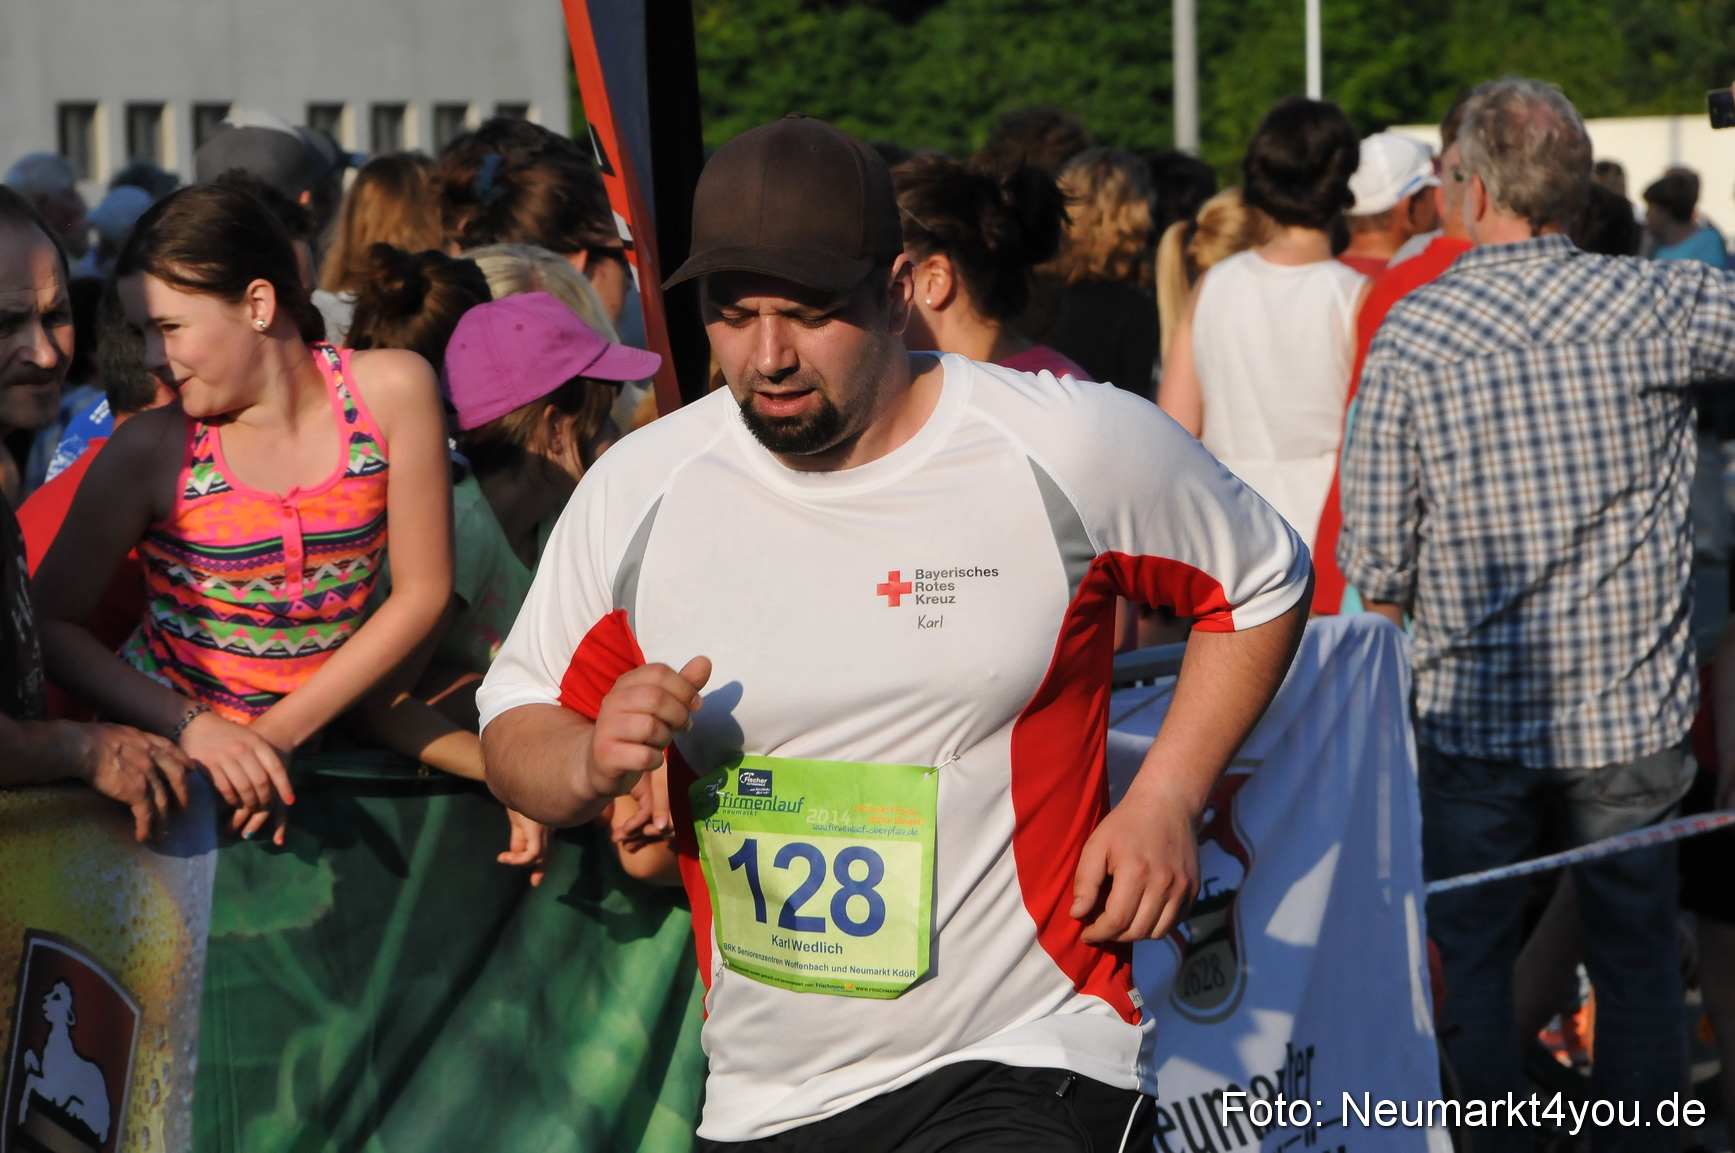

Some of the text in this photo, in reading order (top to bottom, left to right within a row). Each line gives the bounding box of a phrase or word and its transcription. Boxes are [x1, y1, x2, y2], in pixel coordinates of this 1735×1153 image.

[915, 566, 999, 581] Bayerisches
[915, 581, 955, 592] Rotes
[915, 594, 956, 605] Kreuz
[917, 614, 944, 629] Karl
[742, 773, 768, 784] Fischer
[723, 792, 805, 813] firmenlauf
[722, 809, 758, 817] neumarkt
[806, 808, 851, 825] 2014
[728, 838, 886, 937] 128
[771, 934, 843, 954] Karl Wedlich
[724, 942, 916, 978] BRK Seniorenzentren Woffenbach und Neumarkt KdöR
